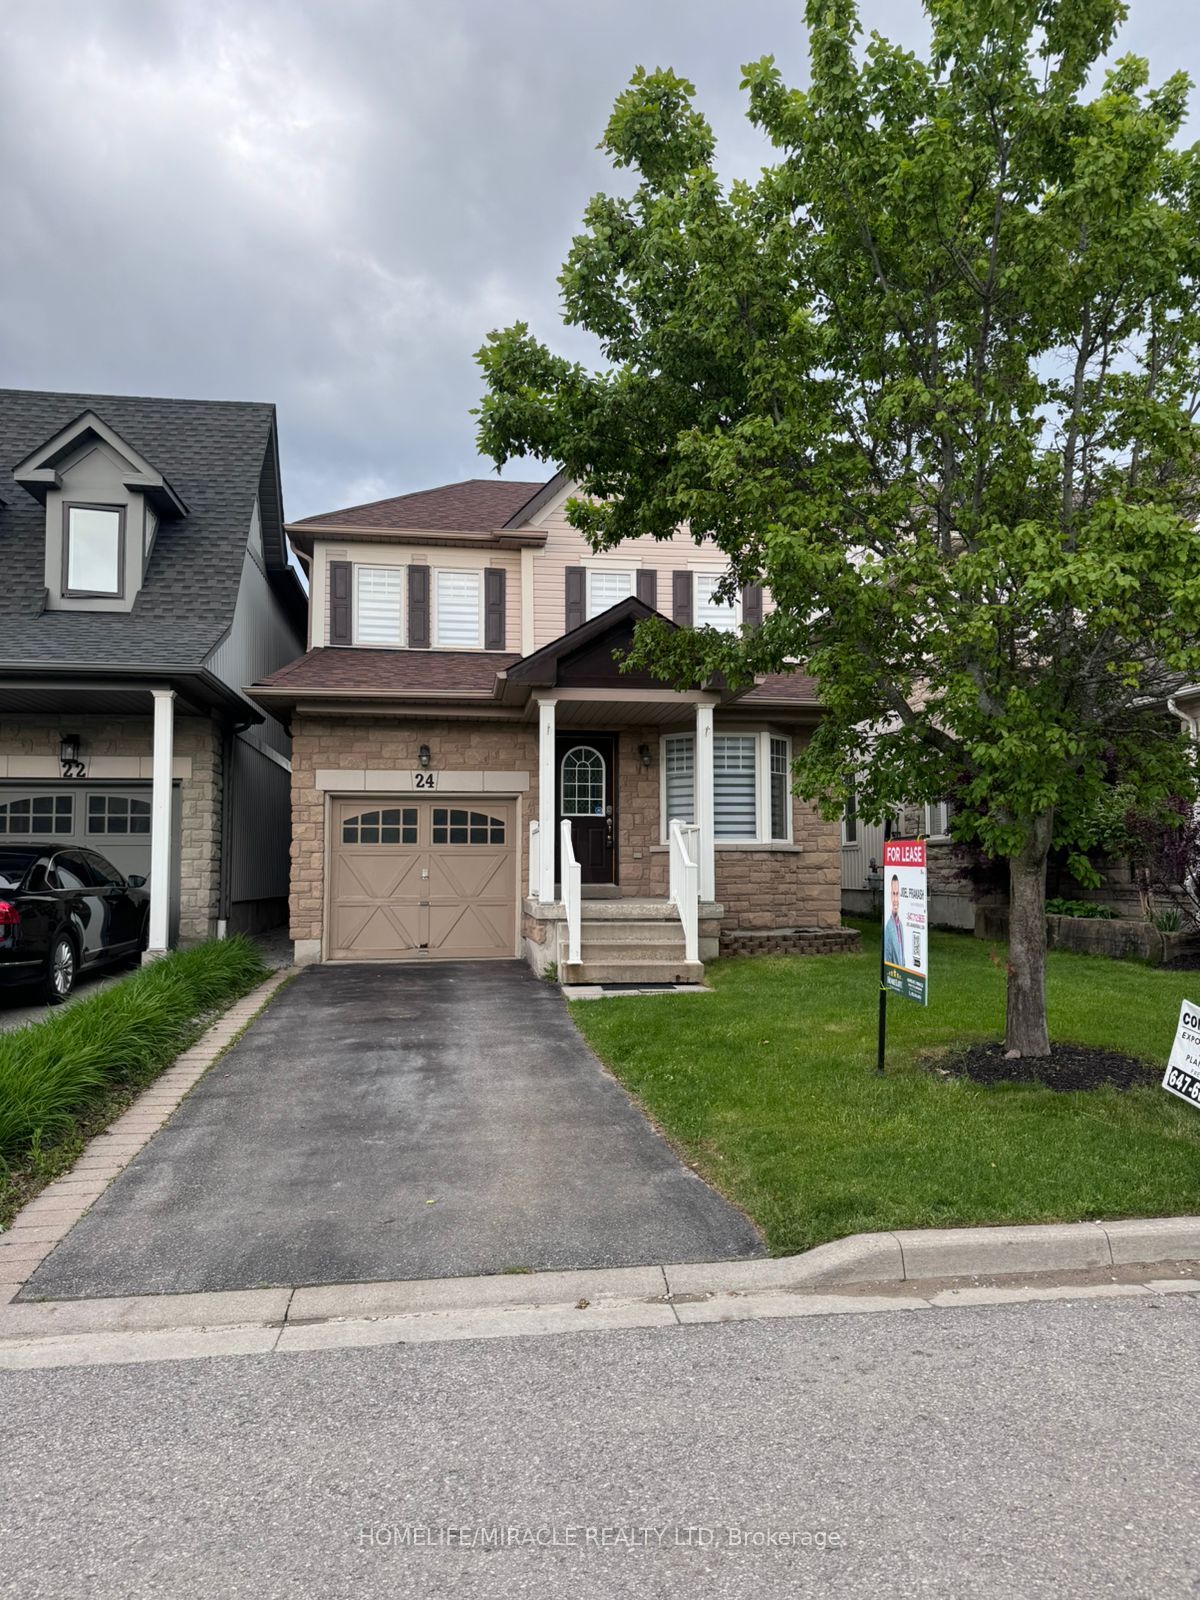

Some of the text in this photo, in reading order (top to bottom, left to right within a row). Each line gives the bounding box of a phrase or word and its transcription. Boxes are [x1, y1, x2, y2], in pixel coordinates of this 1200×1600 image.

[62, 761, 86, 777] 22
[415, 773, 434, 788] 24
[887, 846, 922, 862] FOR LEASE
